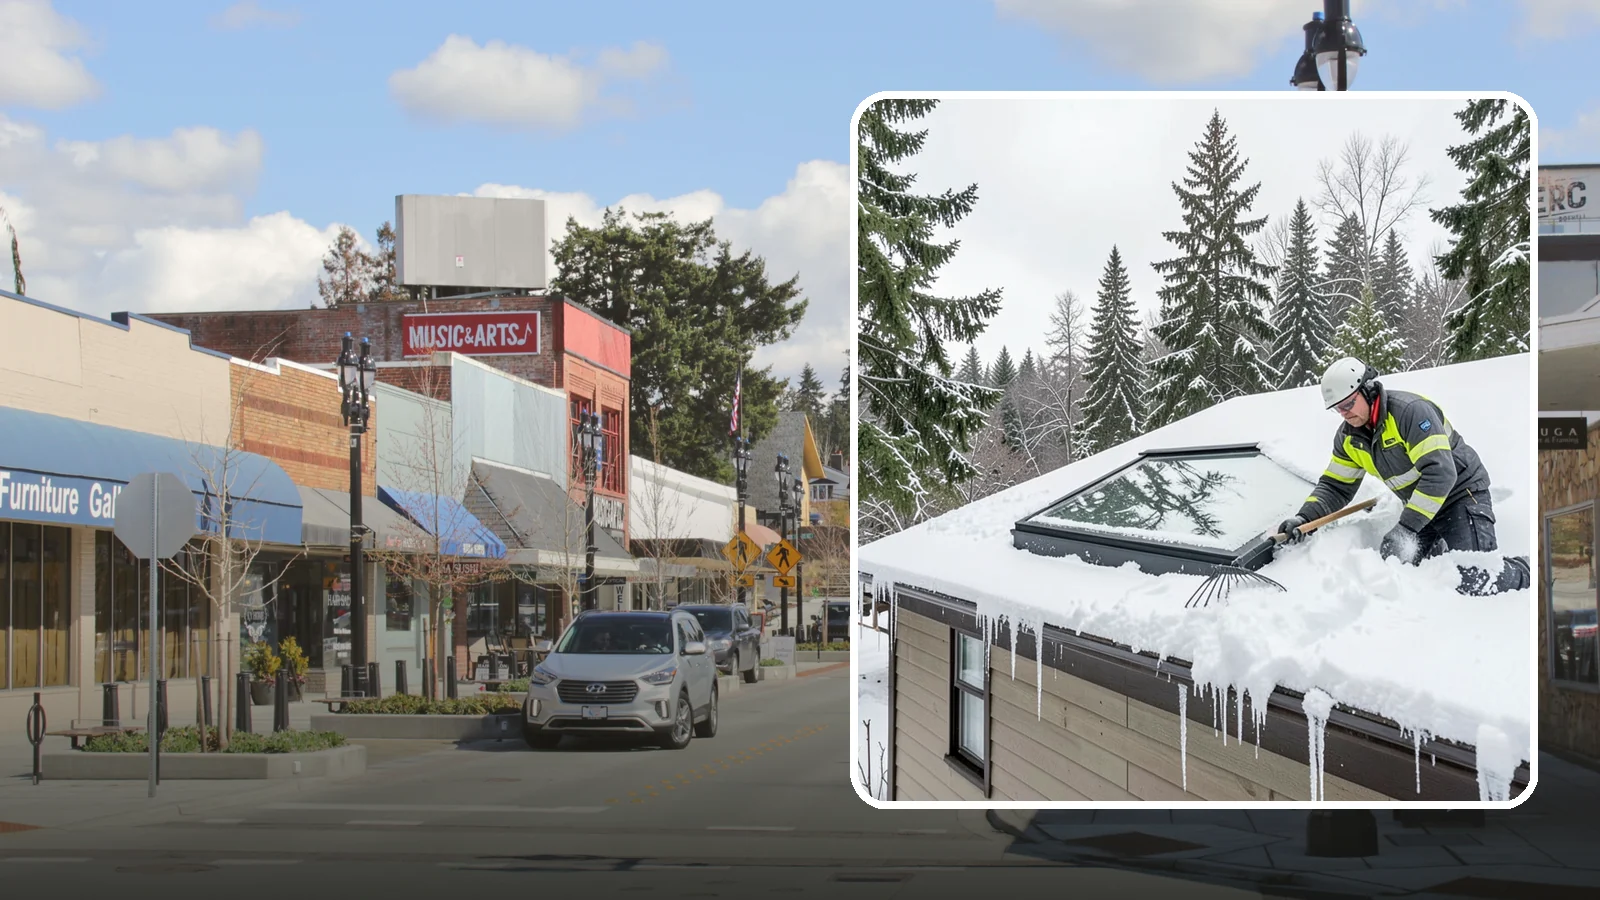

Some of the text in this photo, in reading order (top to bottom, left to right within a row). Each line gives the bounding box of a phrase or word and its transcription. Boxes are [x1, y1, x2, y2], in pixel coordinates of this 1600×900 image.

[0, 471, 122, 519] Furniture Gal
[453, 563, 479, 574] SUSHI
